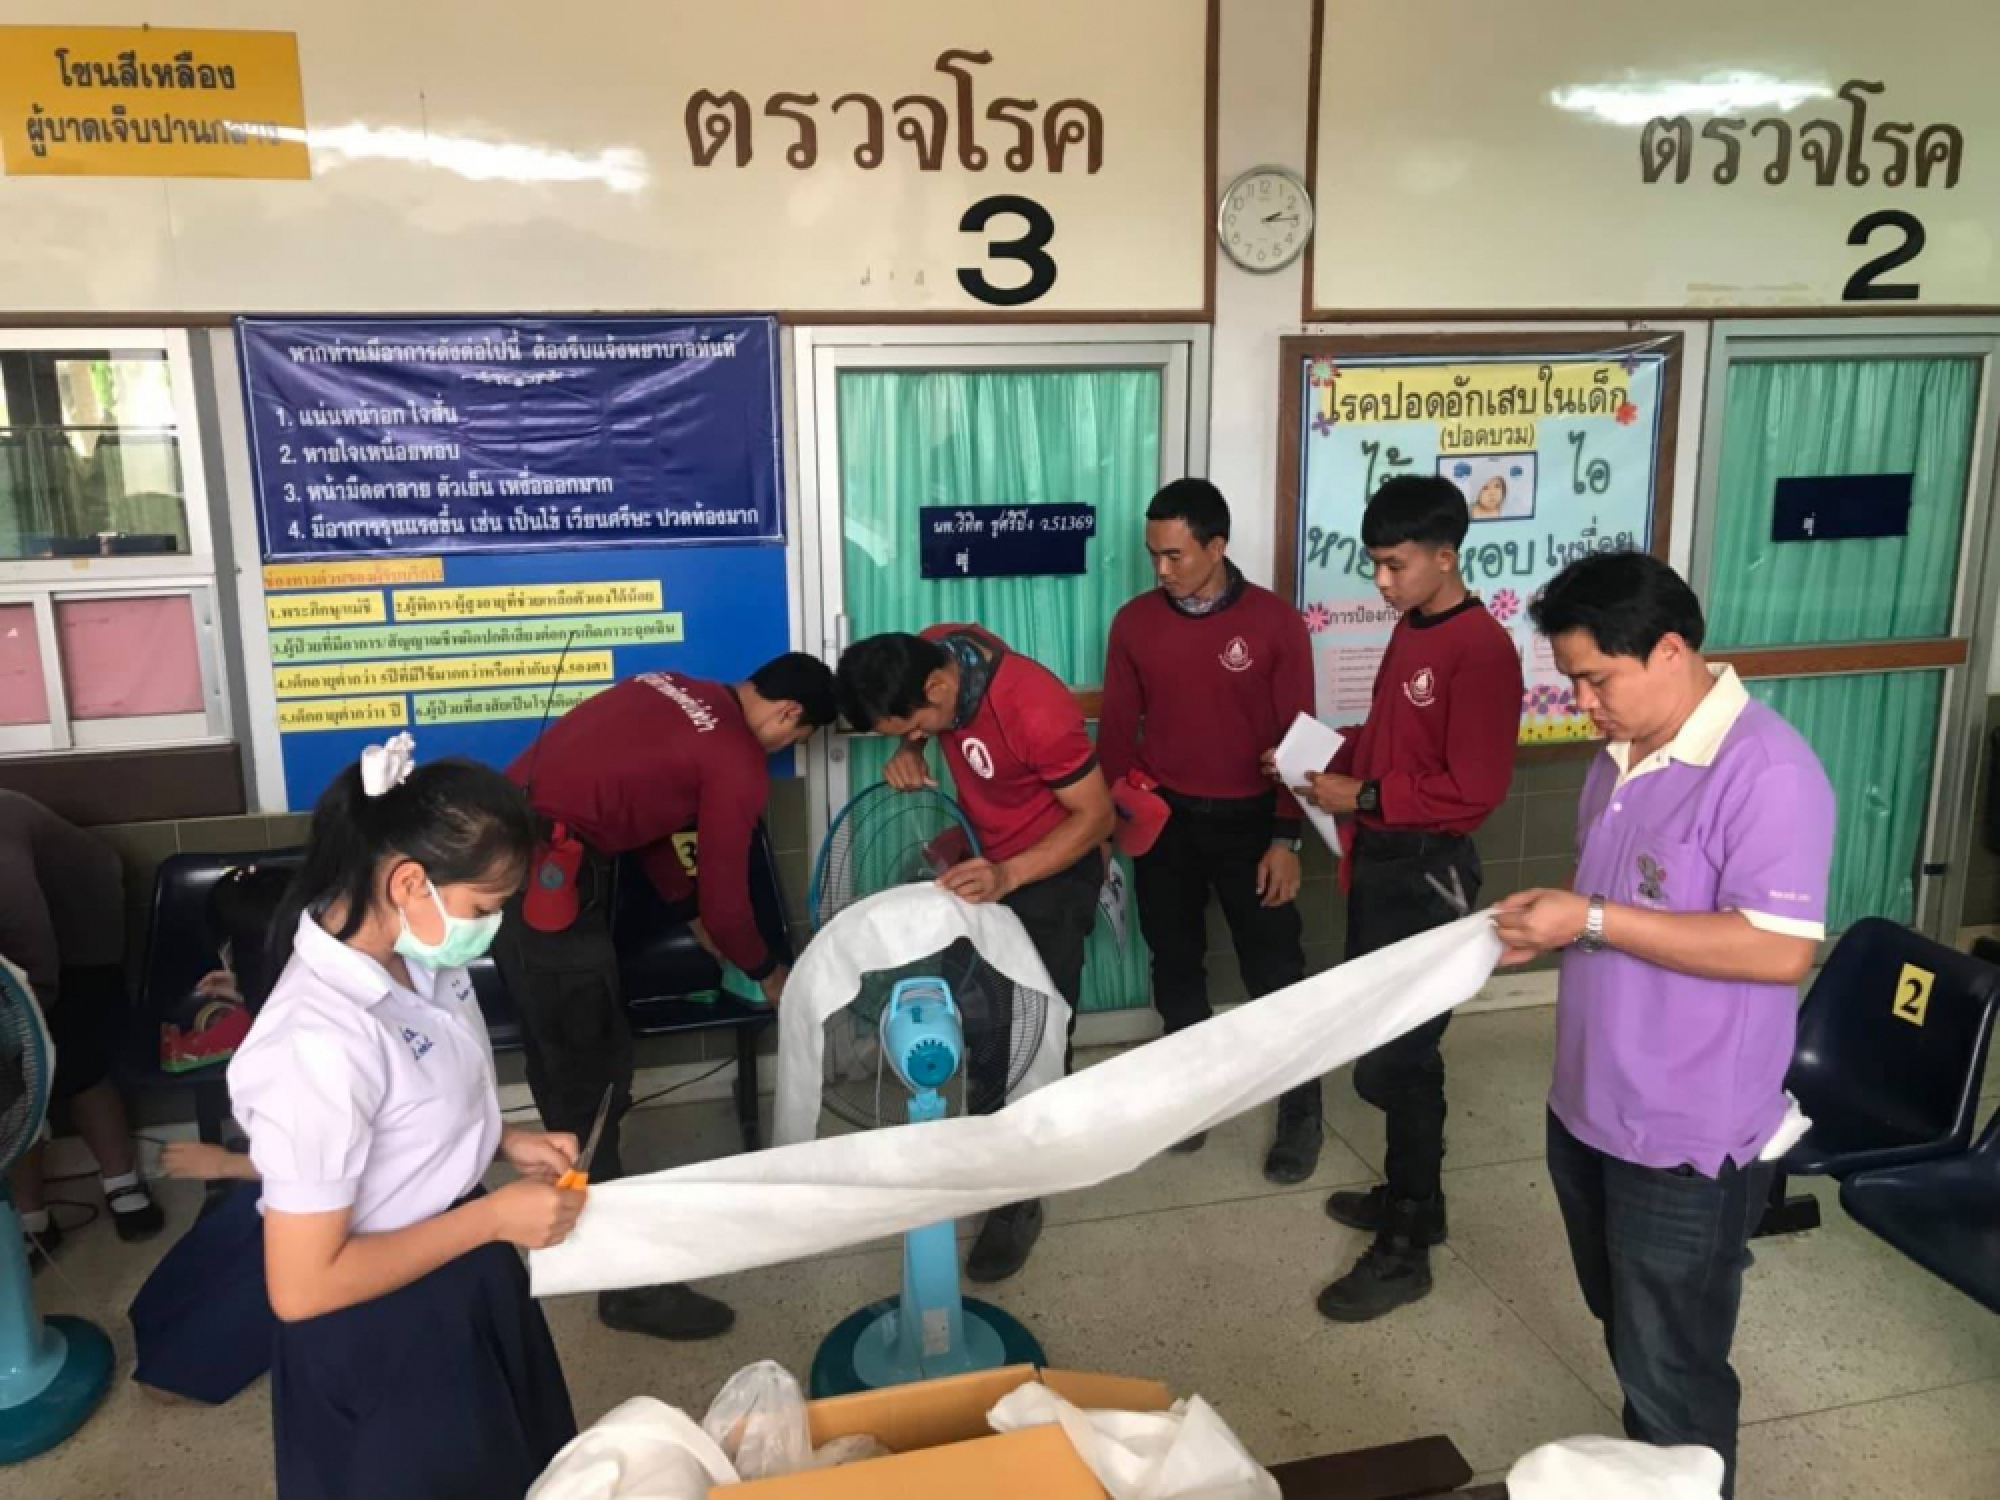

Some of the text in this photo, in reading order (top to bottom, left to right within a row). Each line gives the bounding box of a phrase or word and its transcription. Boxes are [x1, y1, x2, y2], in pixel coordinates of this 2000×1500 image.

[684, 48, 1104, 175] ตรวจโรค
[1640, 79, 1964, 188] ตรวจโรค
[956, 193, 1058, 307] 3
[1842, 209, 1926, 301] 2
[275, 407, 292, 426] 1.
[299, 399, 405, 427] แน่นหน้าอก
[280, 431, 461, 464] 2. หายใจเหนื่อยหอบ
[1439, 423, 1535, 452] (ปอดบวม)
[1567, 430, 1612, 496] ไอ
[284, 482, 301, 502] 3.
[287, 520, 306, 539] 4.
[470, 508, 503, 533] เช่น
[655, 500, 758, 528] ปวดท้องมาก
[1901, 978, 1922, 1016] 2
